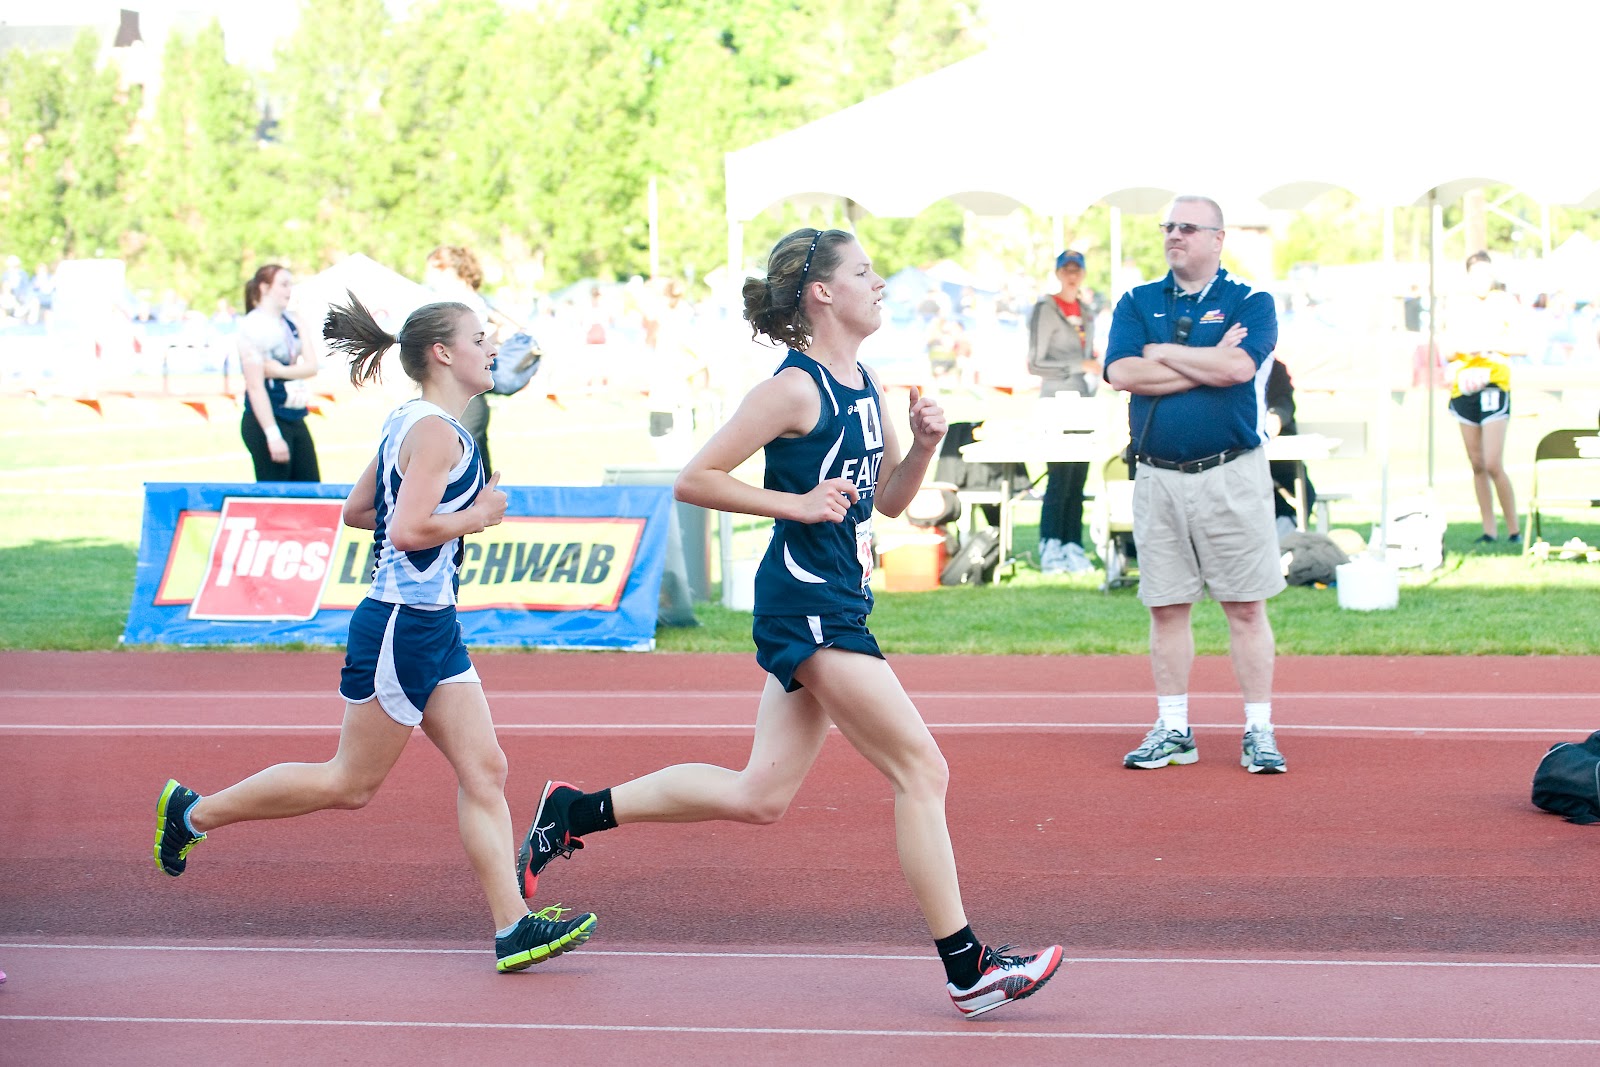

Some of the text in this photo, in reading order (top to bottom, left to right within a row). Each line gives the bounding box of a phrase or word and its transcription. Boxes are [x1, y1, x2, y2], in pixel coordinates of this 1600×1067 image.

[867, 403, 877, 442] 4
[215, 516, 330, 587] Tires
[339, 541, 616, 586] LE CHWAB
